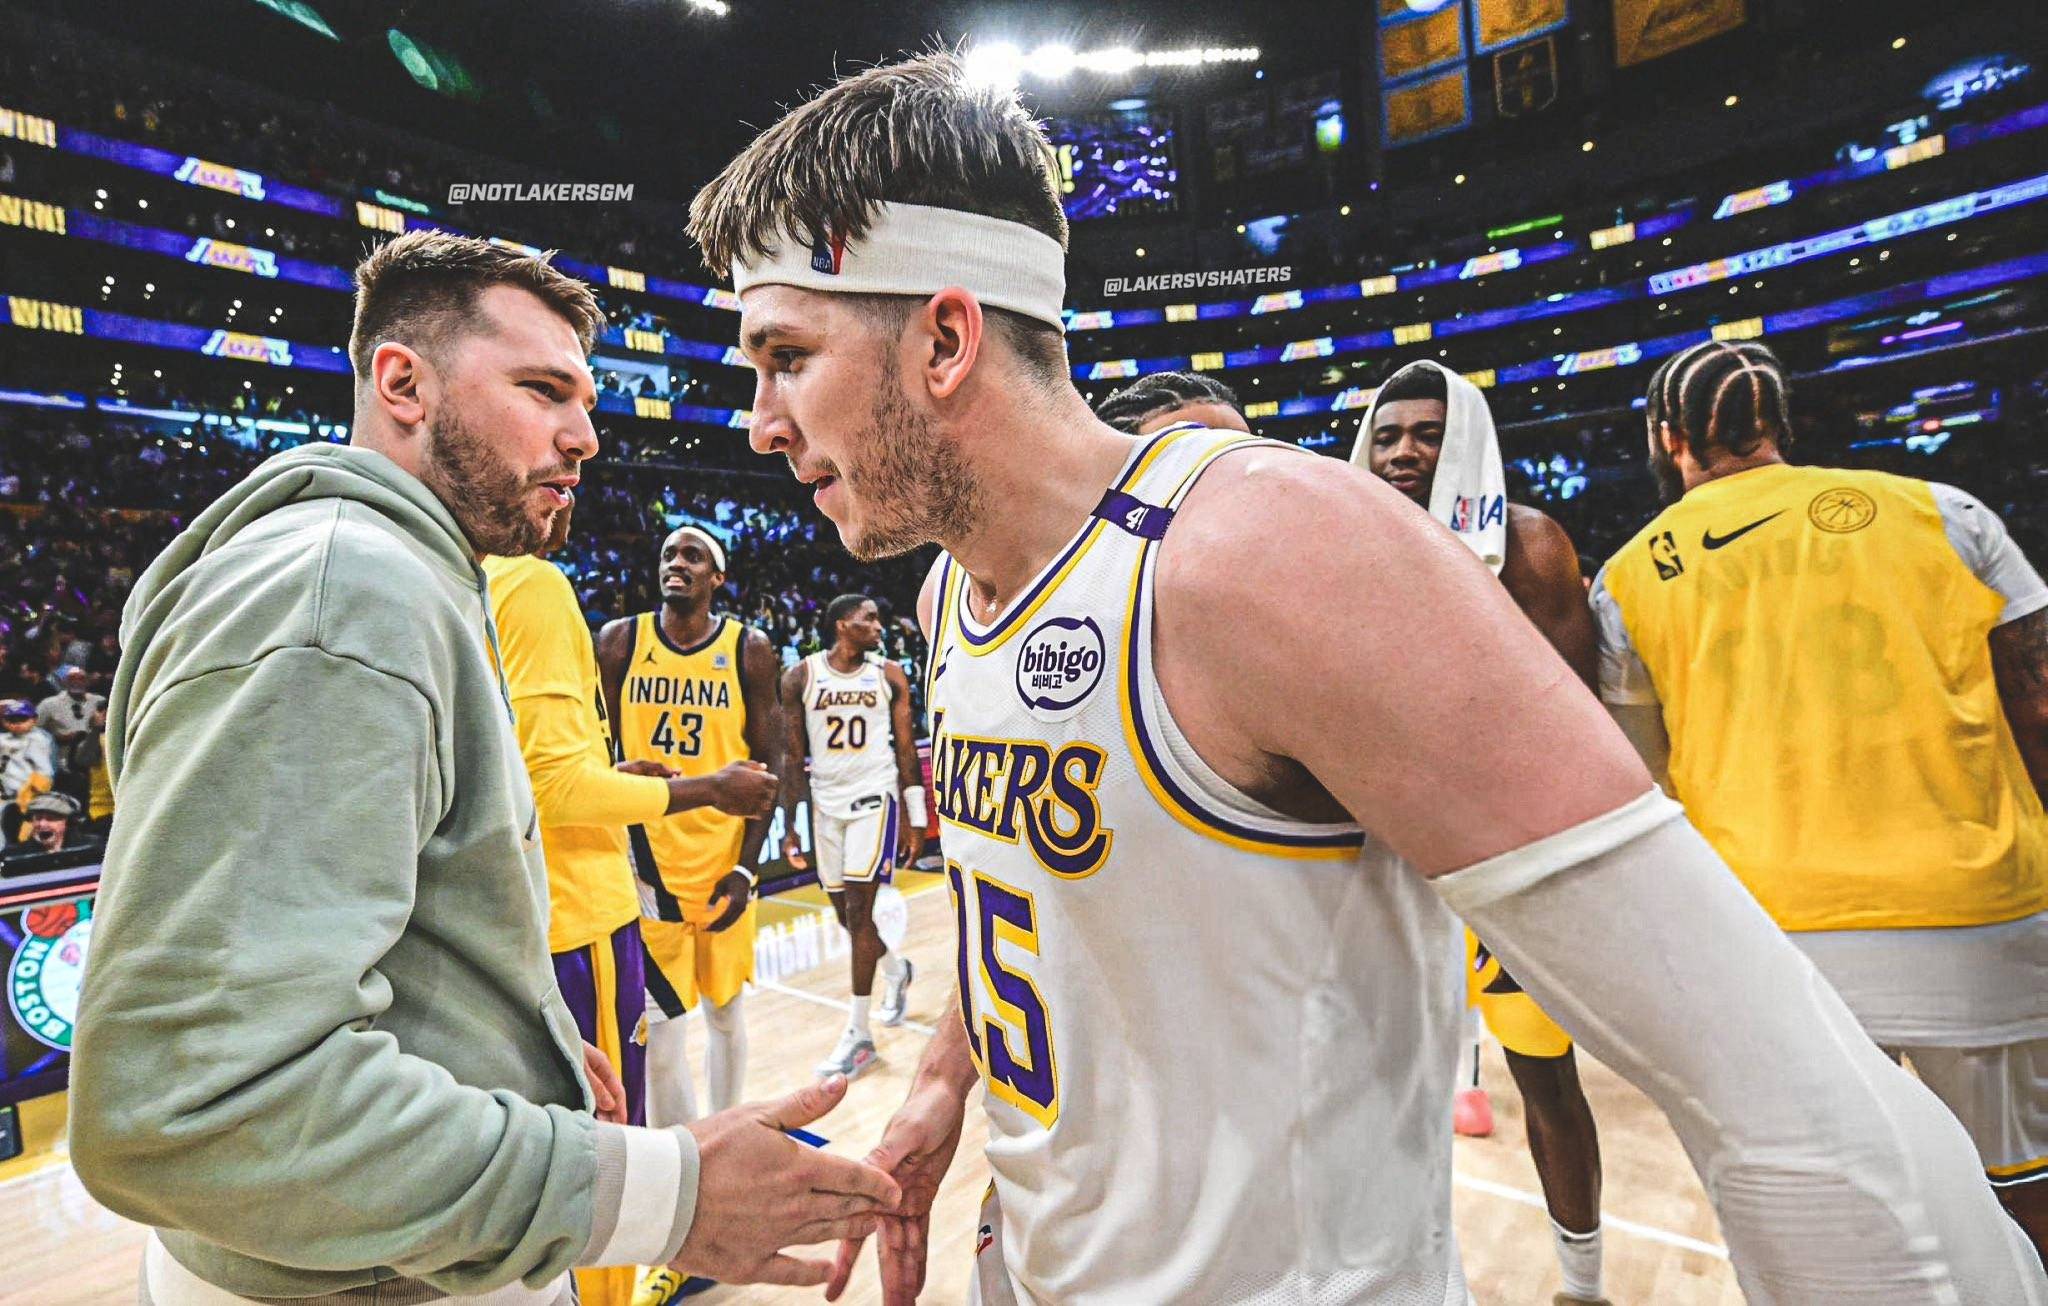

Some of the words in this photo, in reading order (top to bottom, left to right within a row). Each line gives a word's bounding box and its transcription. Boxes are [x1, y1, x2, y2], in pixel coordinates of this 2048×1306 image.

[1023, 641, 1099, 682] bibigo
[629, 676, 730, 710] INDIANA
[813, 687, 878, 711] LAKERS
[1032, 674, 1063, 690] 비비고
[650, 711, 704, 757] 43
[826, 715, 868, 750] 20
[15, 939, 67, 1041] BOSTON
[947, 858, 1060, 1131] 15
